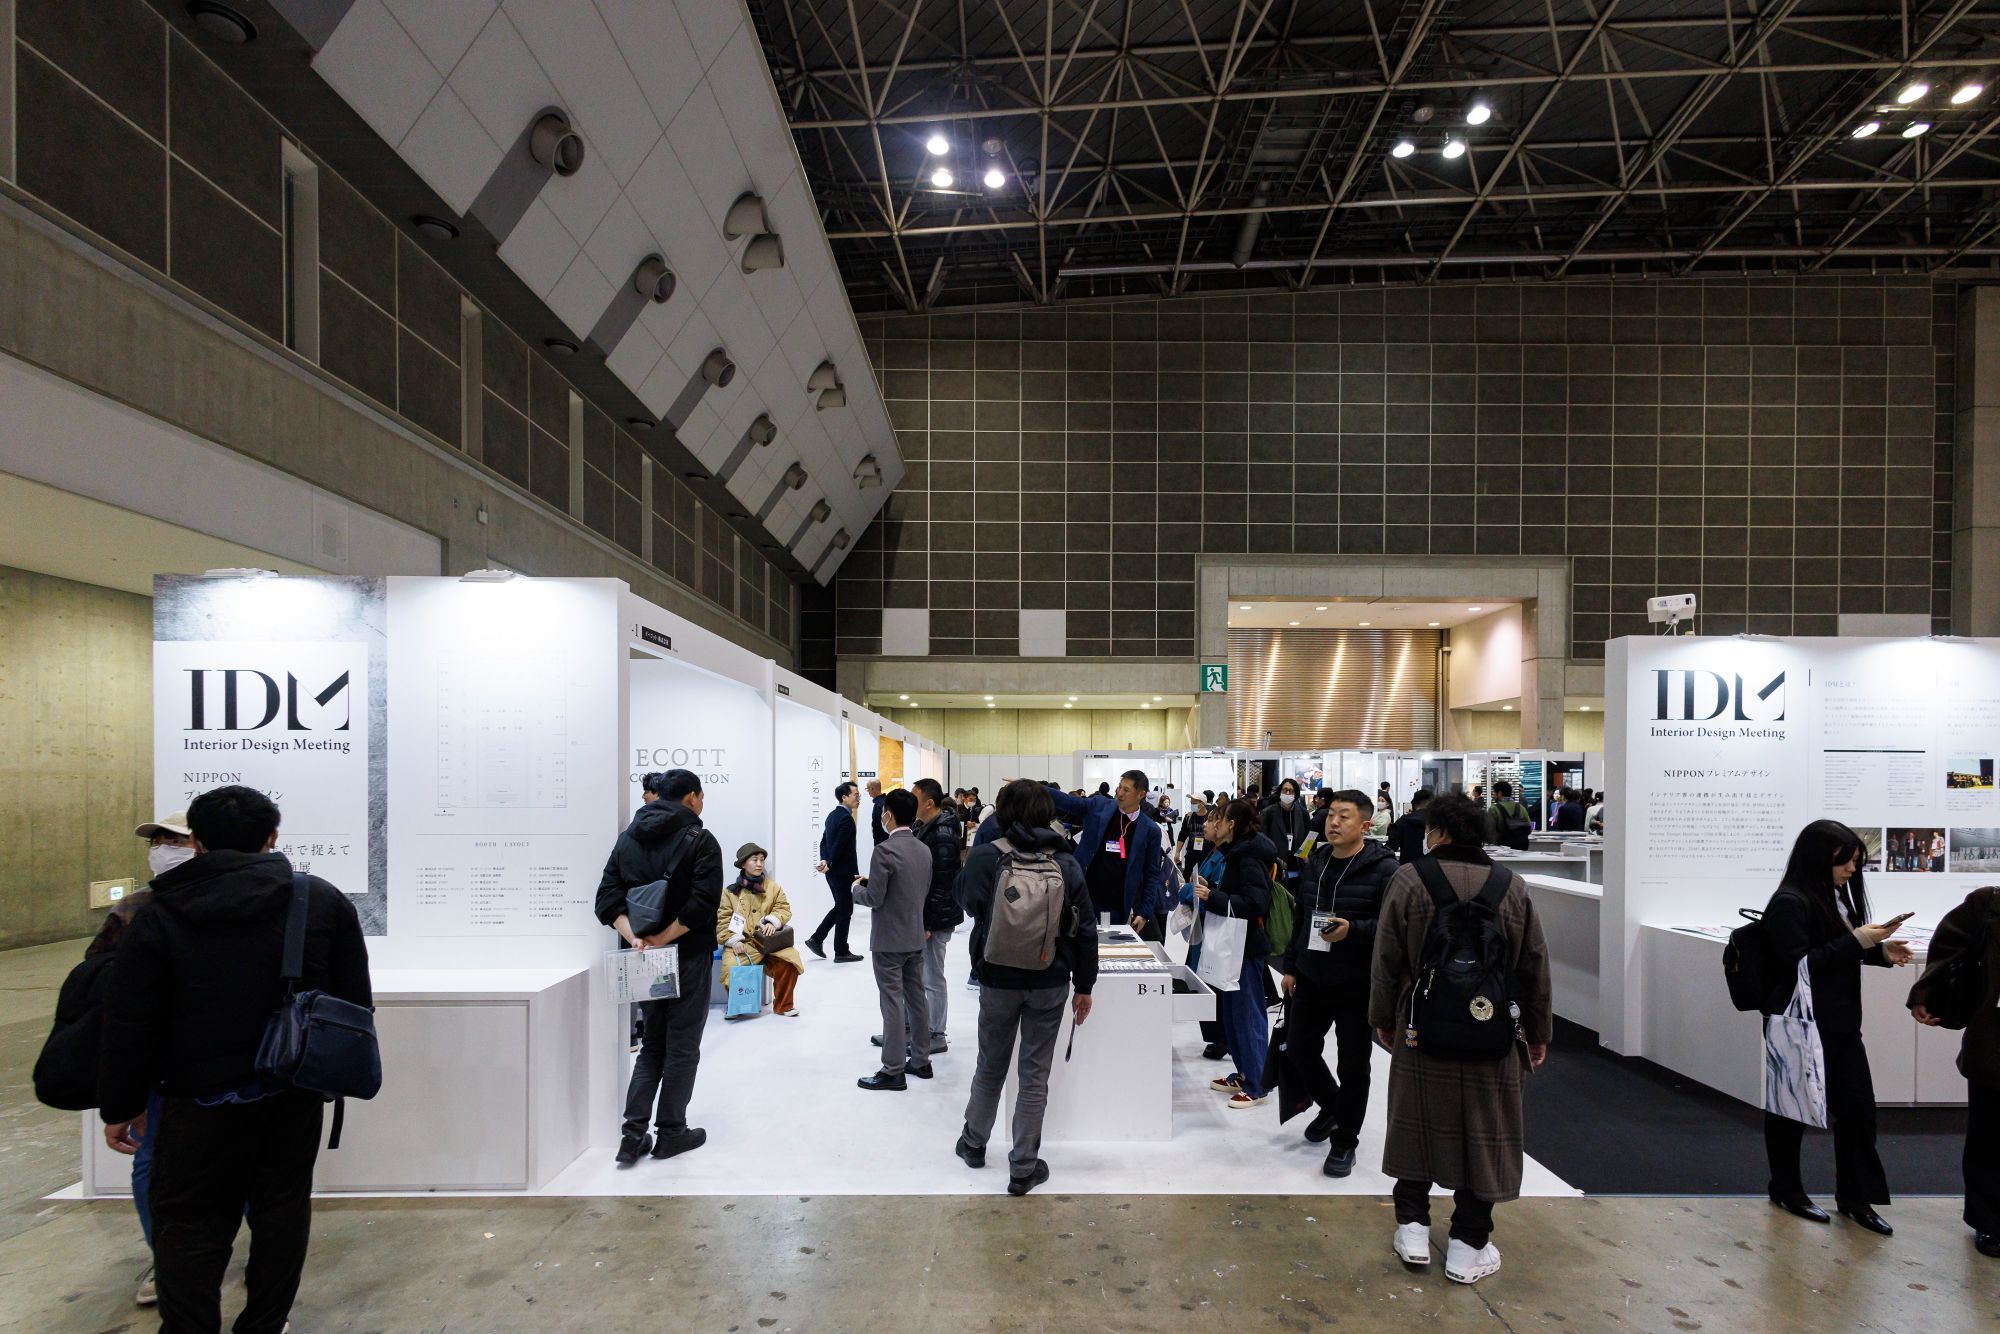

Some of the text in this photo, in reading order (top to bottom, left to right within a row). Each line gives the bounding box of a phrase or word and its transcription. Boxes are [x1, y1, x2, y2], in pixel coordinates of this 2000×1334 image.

[183, 669, 350, 731] IDM
[1650, 669, 1786, 722] IDM
[1650, 726, 1786, 741] Interior Design Meeting
[183, 738, 351, 754] Interior Design Meeting
[635, 748, 726, 767] ECOTT
[183, 772, 242, 783] NIPPON
